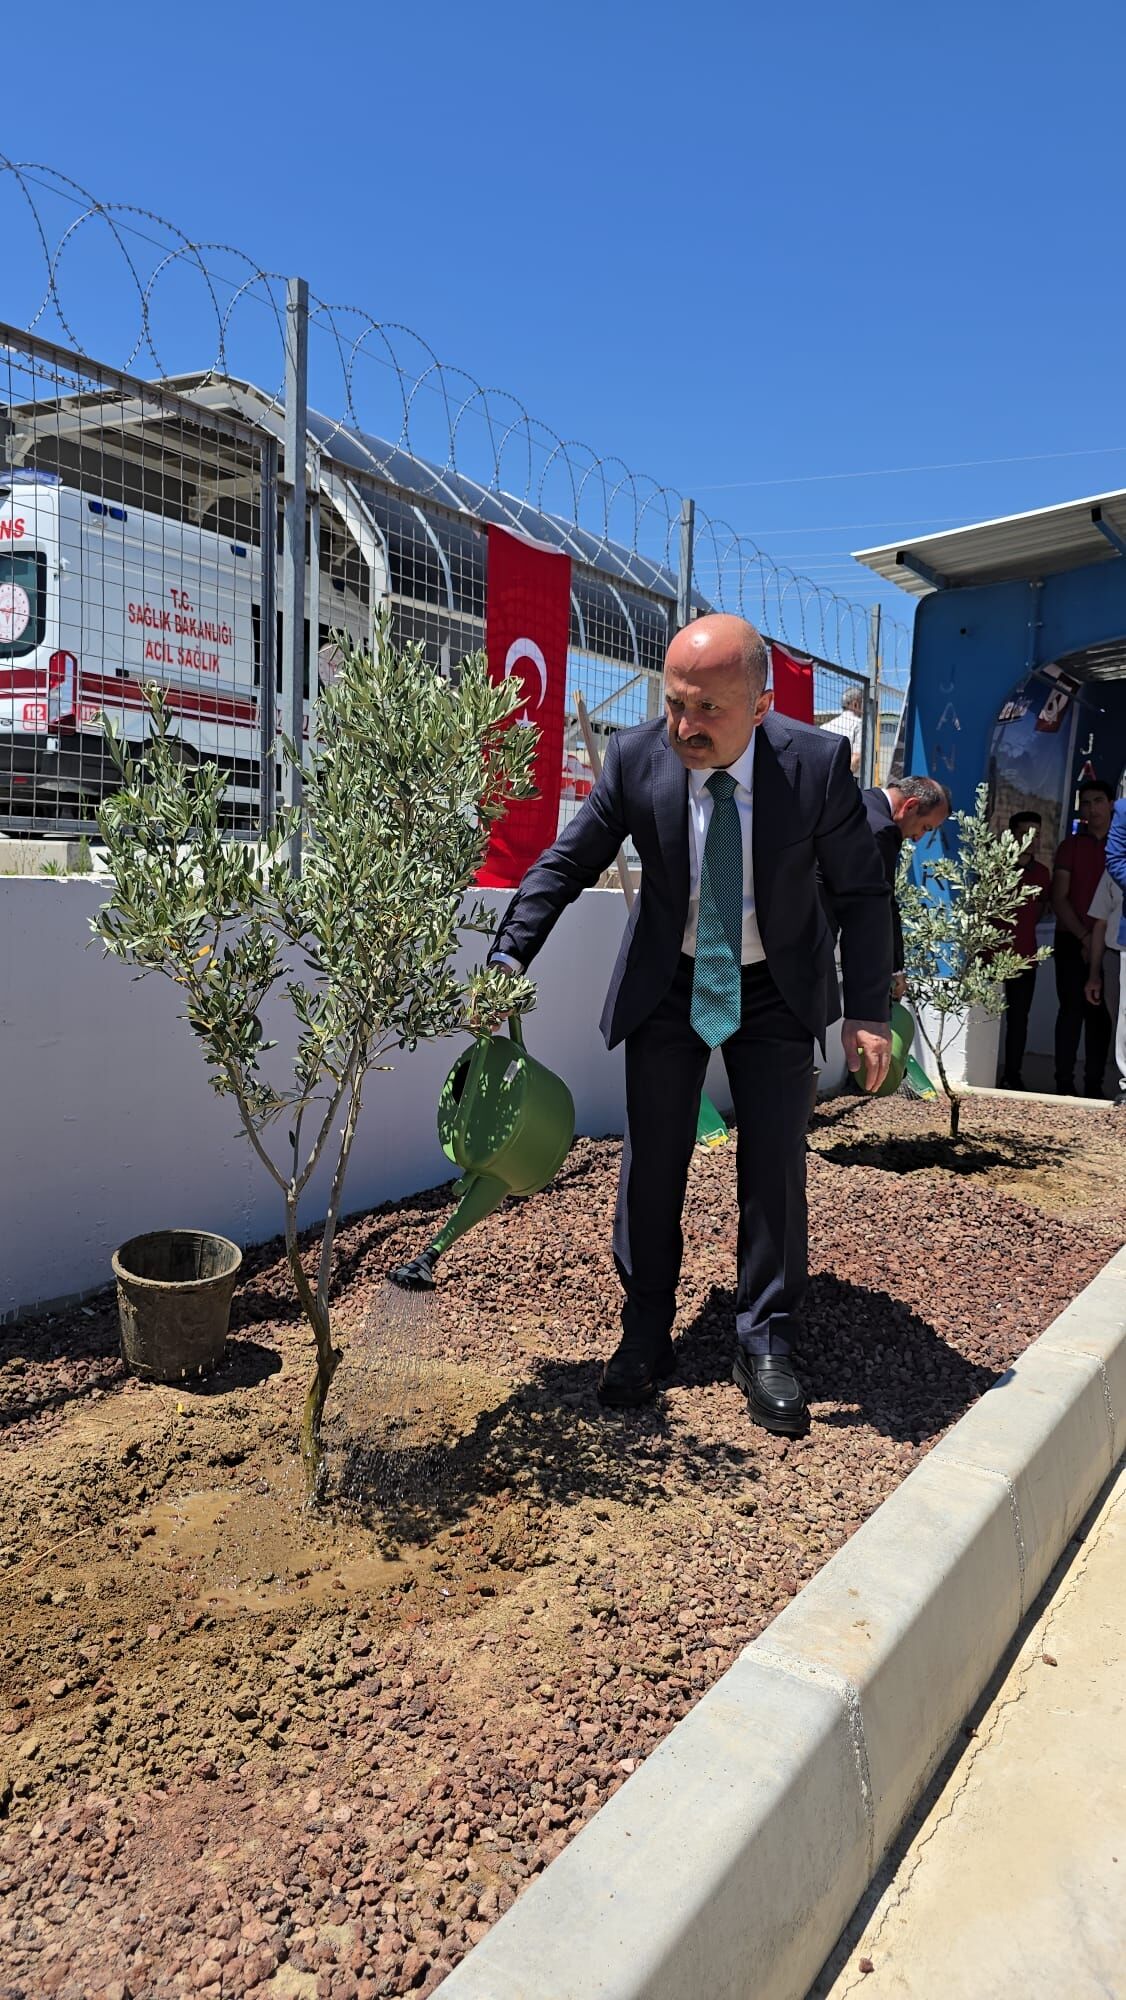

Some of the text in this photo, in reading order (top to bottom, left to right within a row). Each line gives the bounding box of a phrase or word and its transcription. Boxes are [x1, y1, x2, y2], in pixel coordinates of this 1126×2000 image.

[170, 588, 194, 613] T.C.
[128, 602, 232, 646] SAĞLIK BAKANLIĞI
[145, 637, 220, 673] ACİL SAĞLIK
[25, 705, 44, 719] 112
